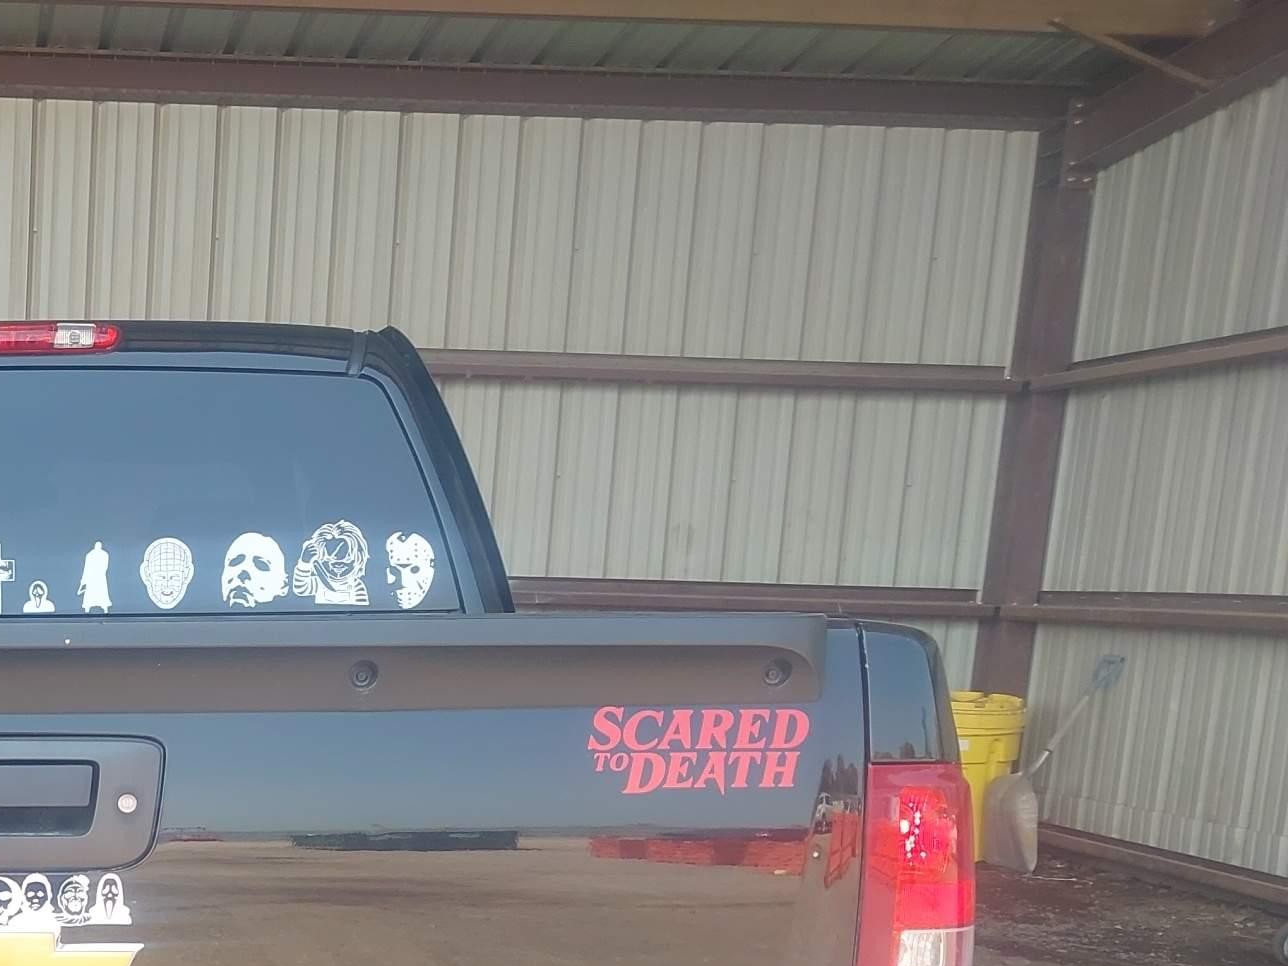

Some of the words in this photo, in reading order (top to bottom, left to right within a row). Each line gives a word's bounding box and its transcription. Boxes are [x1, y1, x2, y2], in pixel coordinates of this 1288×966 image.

[587, 705, 810, 750] SCARED
[593, 752, 630, 772] TO
[622, 751, 801, 795] DEATH
